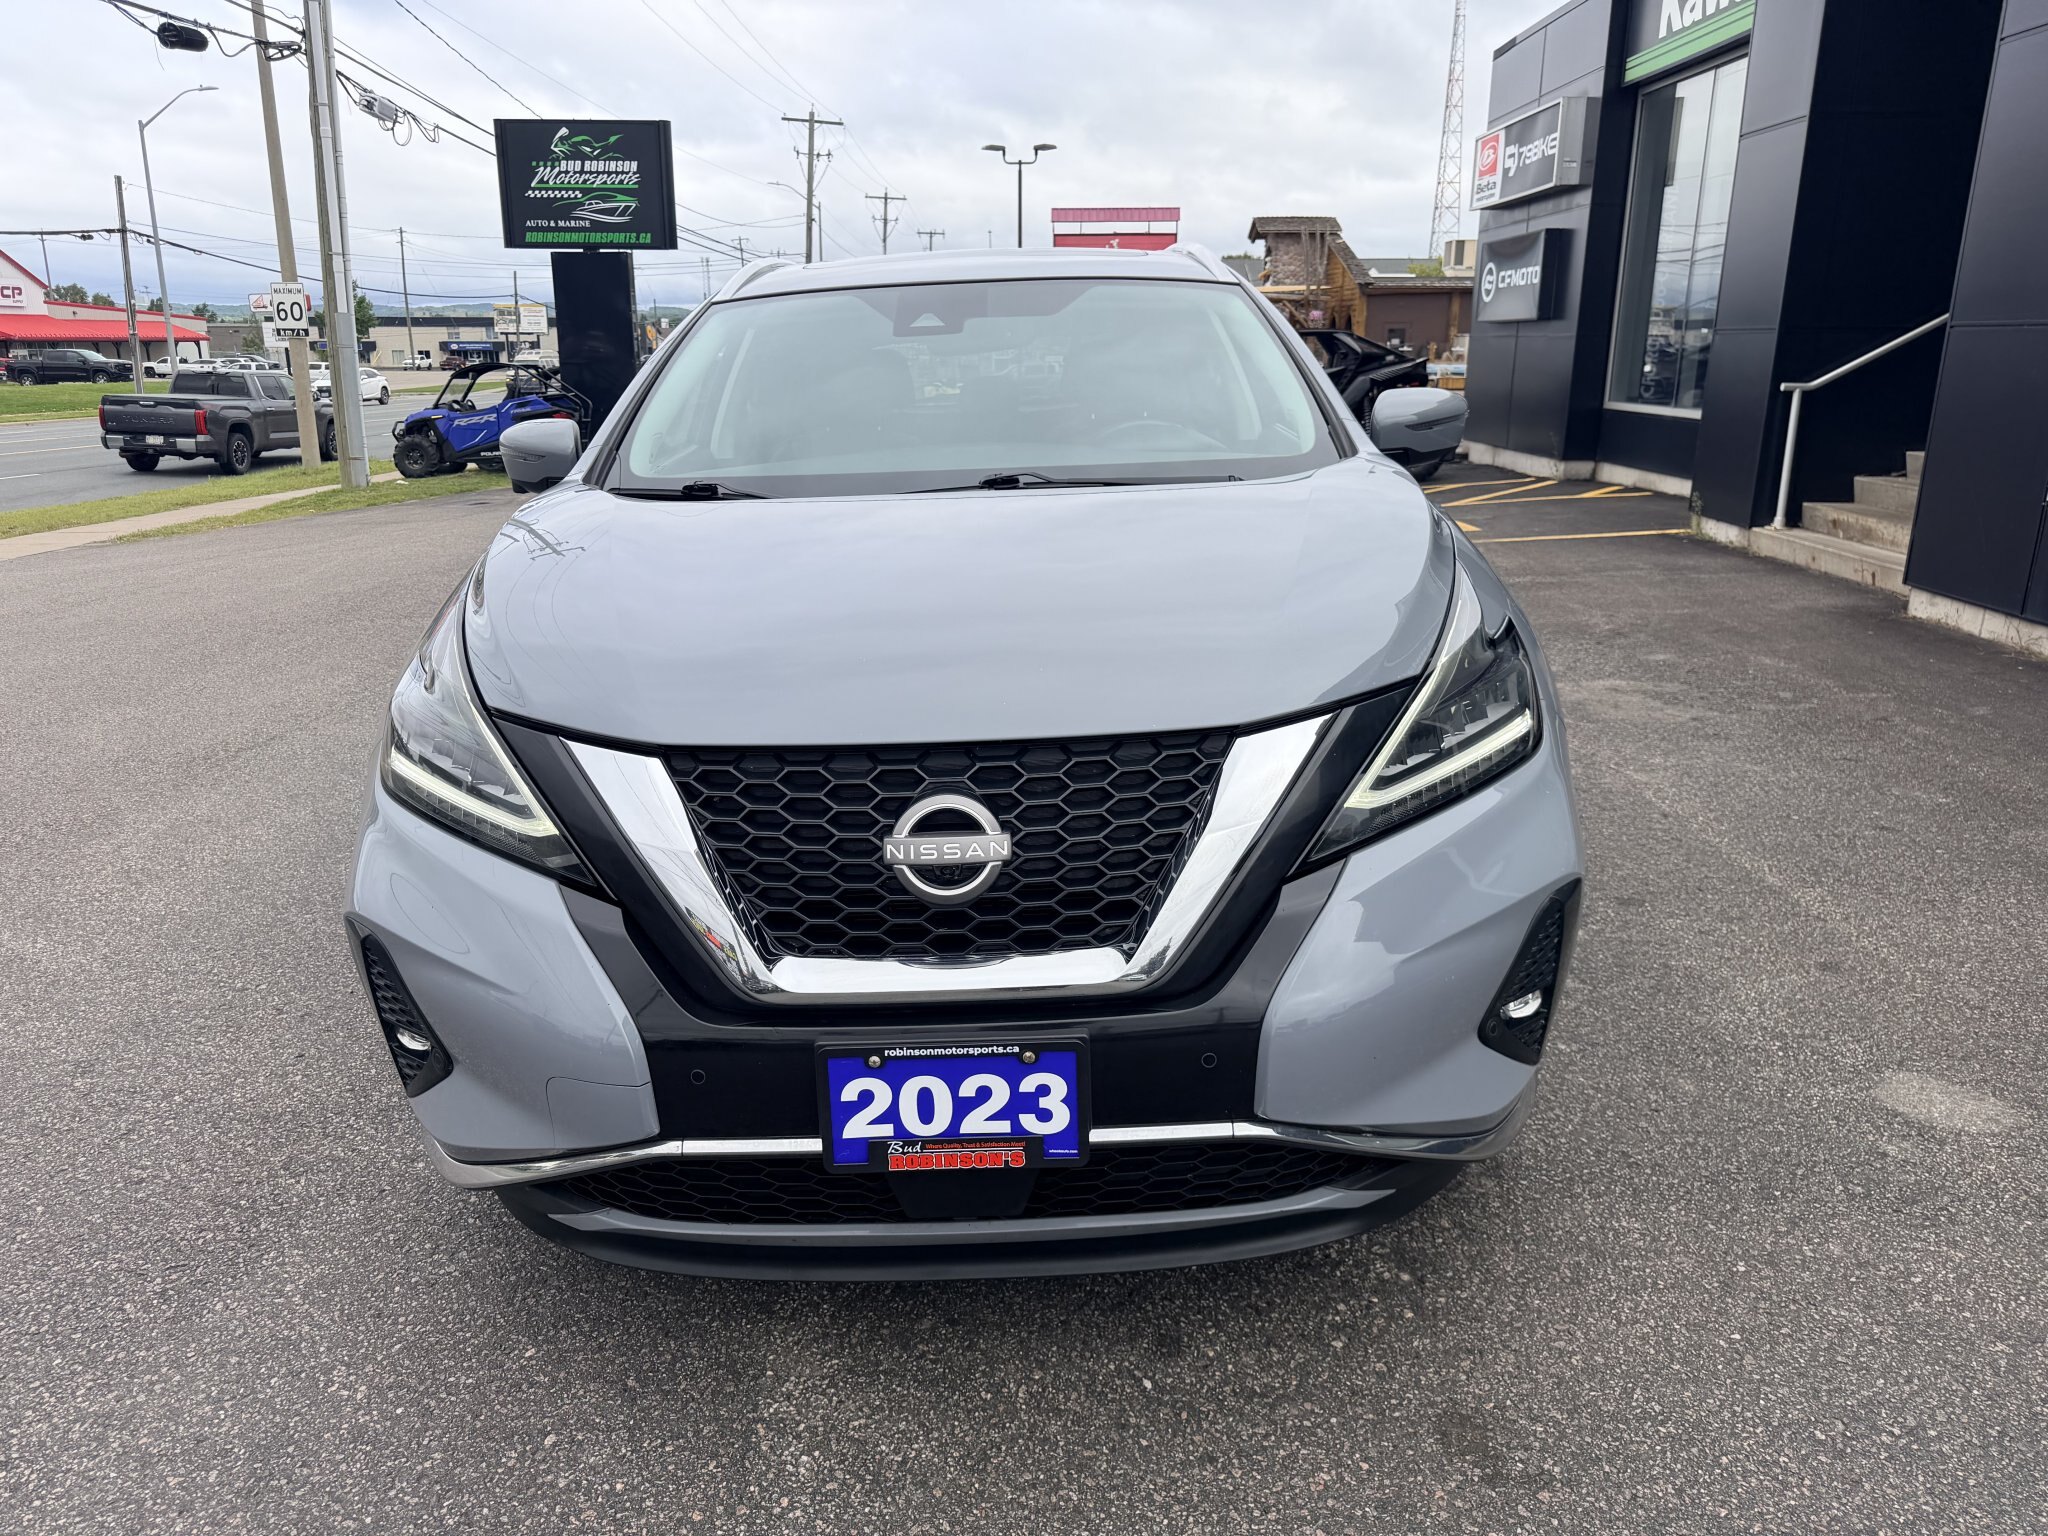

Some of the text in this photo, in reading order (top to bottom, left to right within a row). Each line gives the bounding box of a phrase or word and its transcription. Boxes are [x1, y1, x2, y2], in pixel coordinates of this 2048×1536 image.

[560, 160, 638, 172] BUD ROBINSON
[531, 167, 641, 188] Motorsports
[1476, 180, 1497, 195] Beta
[525, 219, 591, 228] AUTO & MARINE
[525, 231, 652, 244] ROBINSONMOTORSPORTS.CA
[1497, 265, 1541, 289] CFMOTO
[273, 287, 302, 295] MAXIMUM
[276, 301, 304, 322] 60
[280, 329, 305, 337] km/h
[122, 415, 175, 425] TUNDRA
[452, 413, 498, 428] RZR
[886, 840, 1008, 860] NISSAN
[884, 1044, 1020, 1057] robinsonmotorsports.ca
[839, 1072, 1071, 1139] 2023
[887, 1141, 922, 1154] Bud
[888, 1150, 1026, 1171] ROBINSON'S
